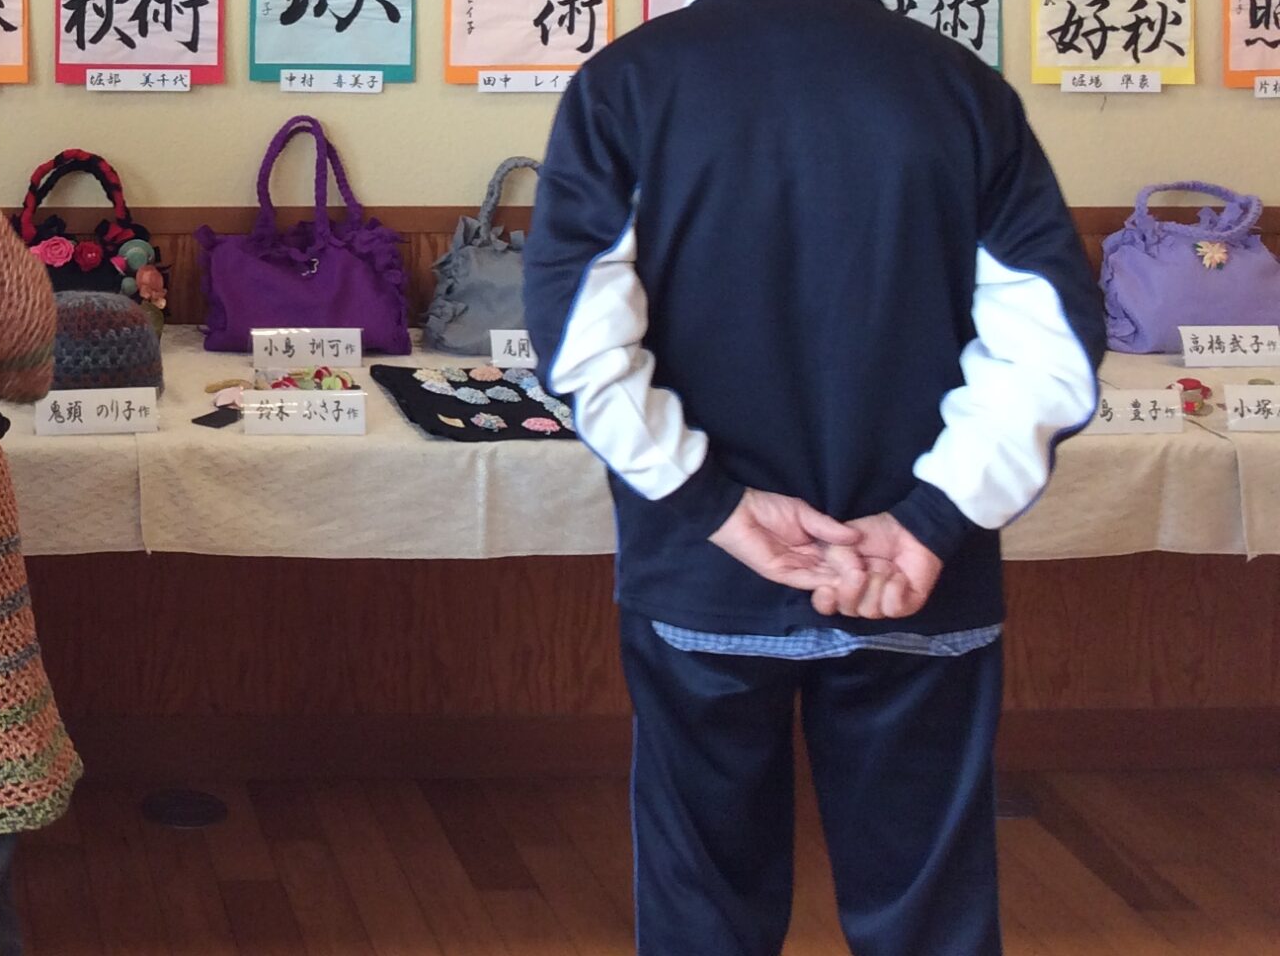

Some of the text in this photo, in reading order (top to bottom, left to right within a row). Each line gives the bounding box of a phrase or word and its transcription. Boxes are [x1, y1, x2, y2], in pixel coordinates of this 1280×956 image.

[90, 72, 188, 90] 堀部 美千代
[285, 73, 379, 89] 中村 喜美子
[482, 73, 511, 89] 田中
[263, 338, 295, 358] 小島
[48, 401, 84, 424] 鬼頭
[256, 399, 290, 422] 鈴木
[1233, 397, 1280, 420] 小塚
